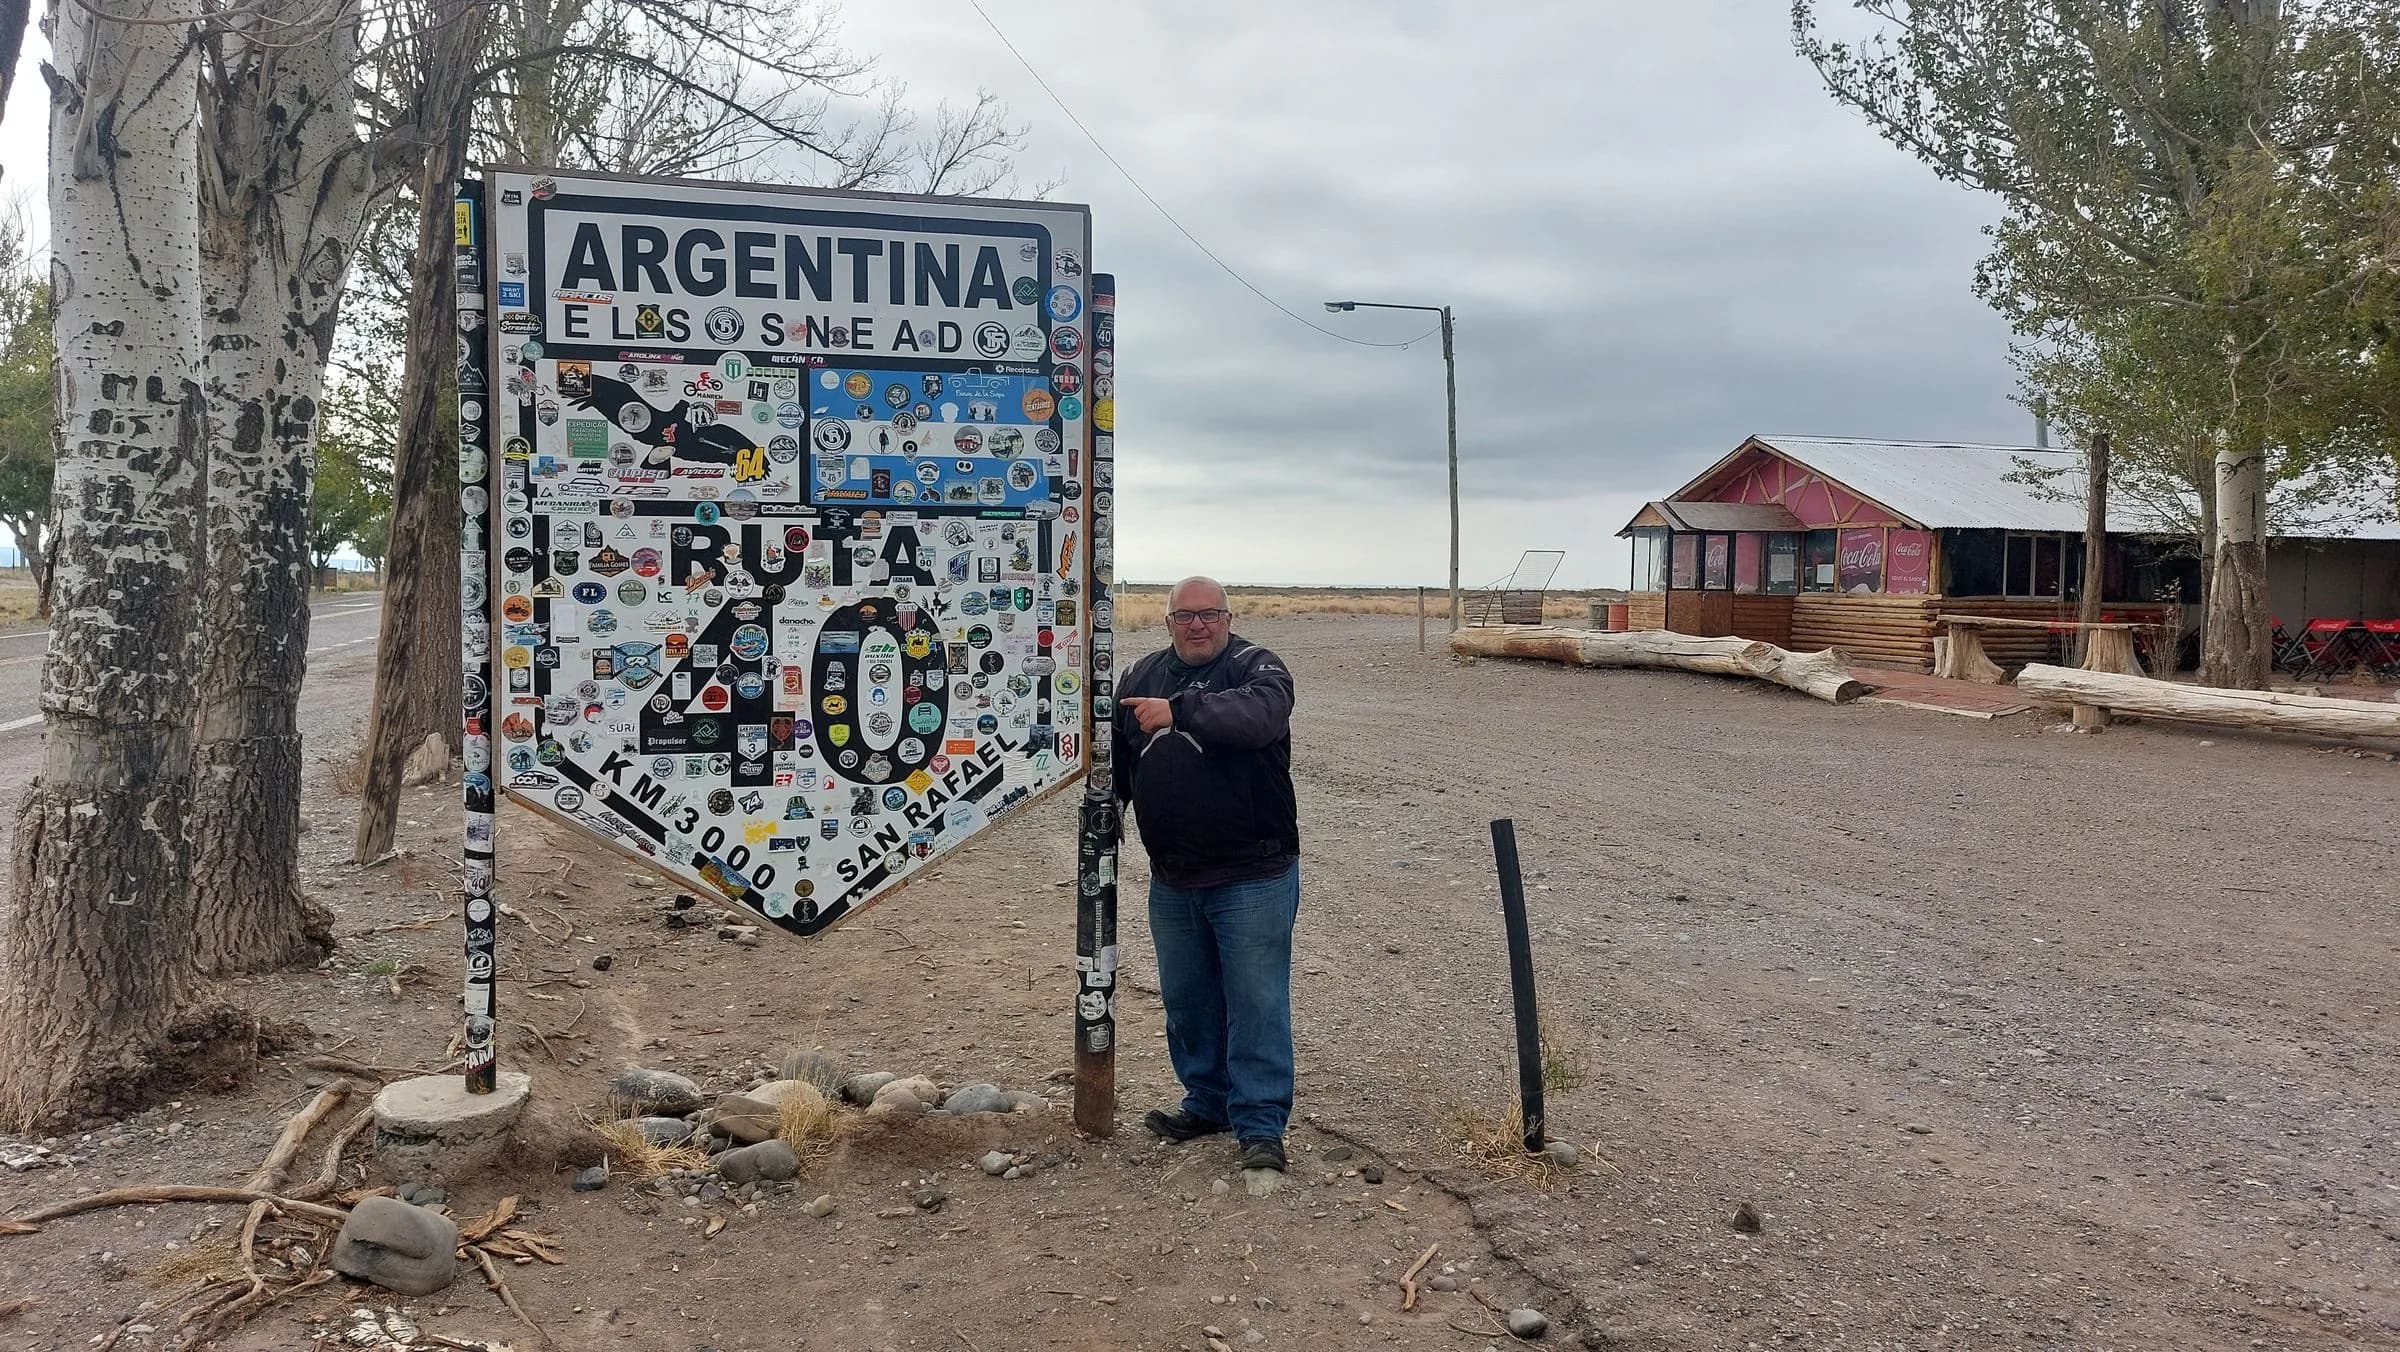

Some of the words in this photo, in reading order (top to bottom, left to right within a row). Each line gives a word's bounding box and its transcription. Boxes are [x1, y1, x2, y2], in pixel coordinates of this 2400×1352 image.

[560, 222, 1013, 311] ARGENTINA
[1099, 331, 1111, 342] 40
[567, 420, 607, 429] EXPEDIÇÃO
[671, 523, 936, 587] RUTA
[919, 559, 932, 567] 90
[1895, 542, 1923, 556] Coca-Cola
[582, 588, 598, 597] FL
[639, 597, 950, 787] 40
[599, 751, 667, 811] KM
[675, 807, 776, 890] 3000
[837, 823, 901, 883] SAN
[903, 733, 1018, 829] RAFAEL
